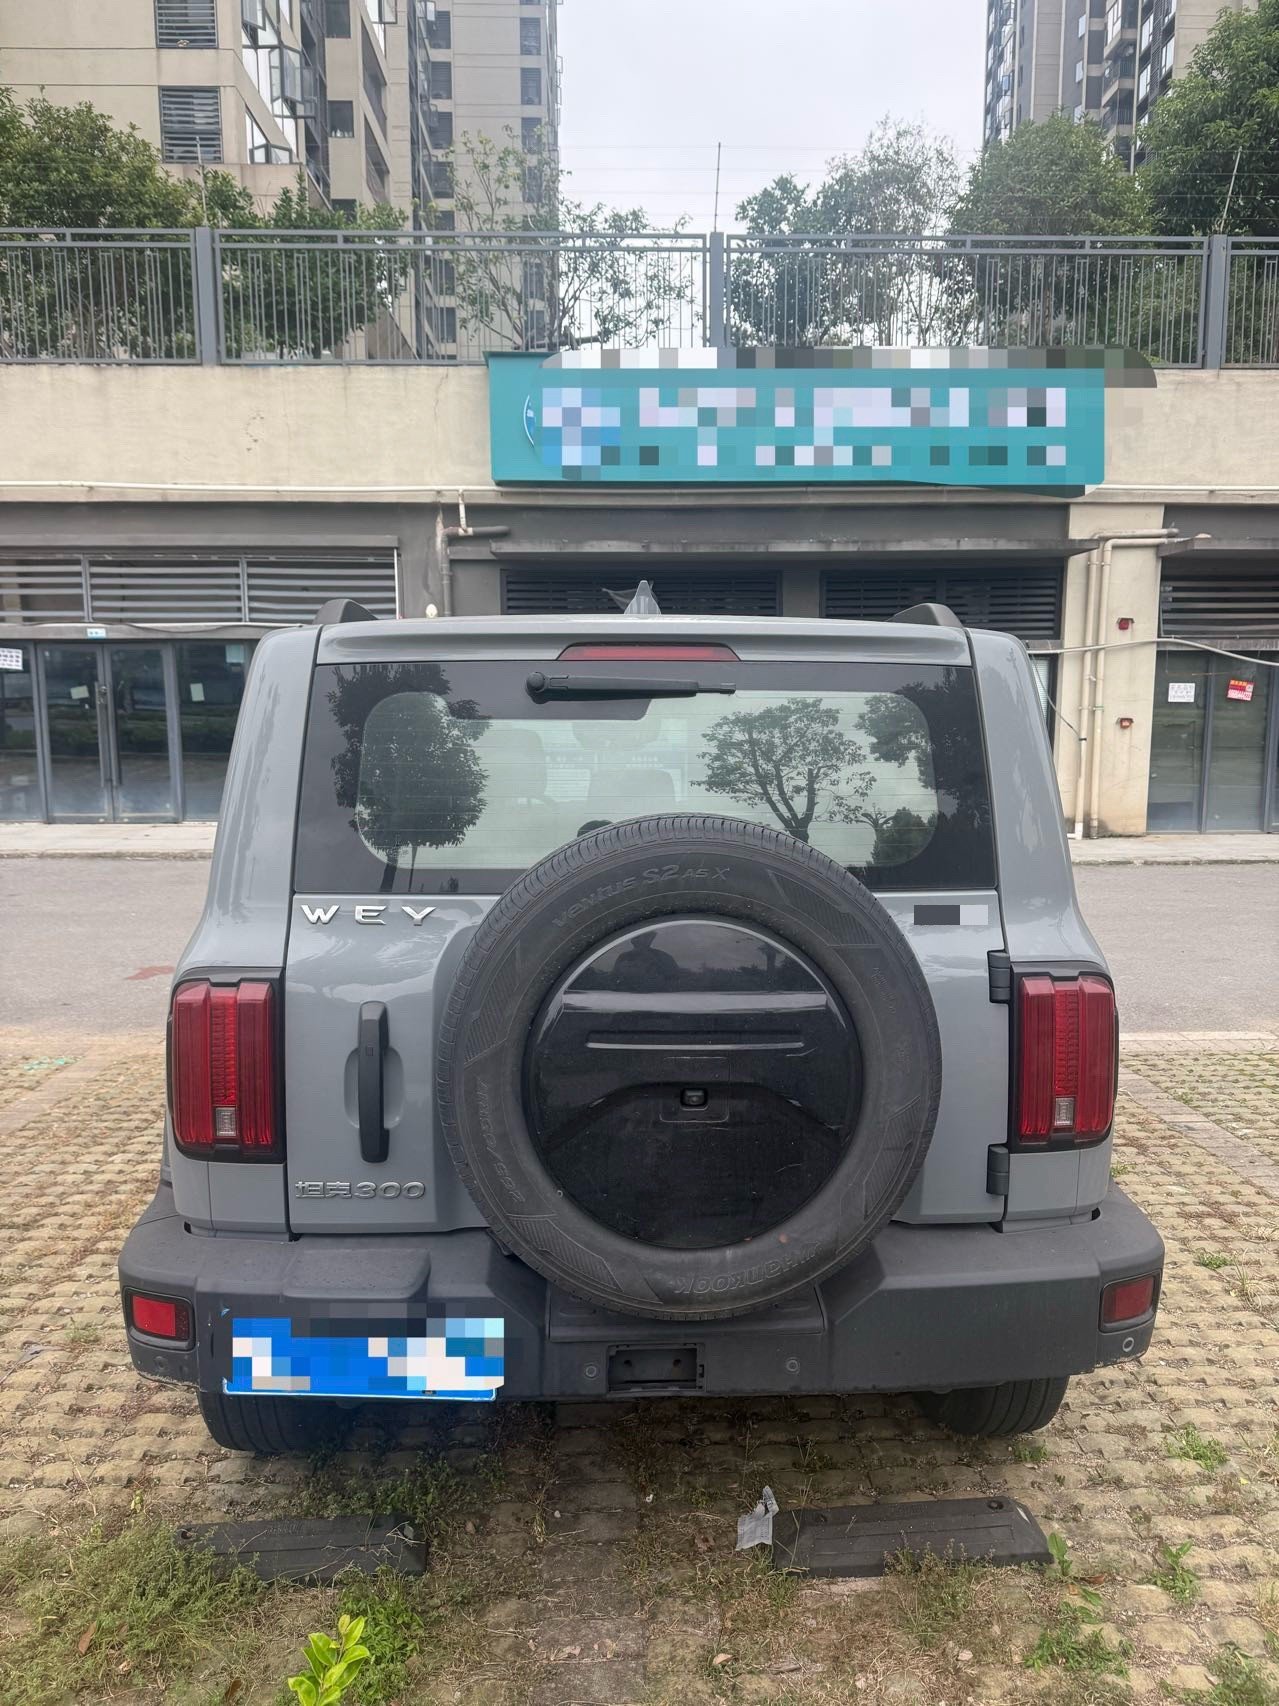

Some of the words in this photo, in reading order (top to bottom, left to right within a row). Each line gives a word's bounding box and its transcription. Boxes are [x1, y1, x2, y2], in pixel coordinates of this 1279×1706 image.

[643, 864, 679, 883] S2
[301, 904, 437, 926] WEY
[295, 1181, 425, 1199] 坦克300
